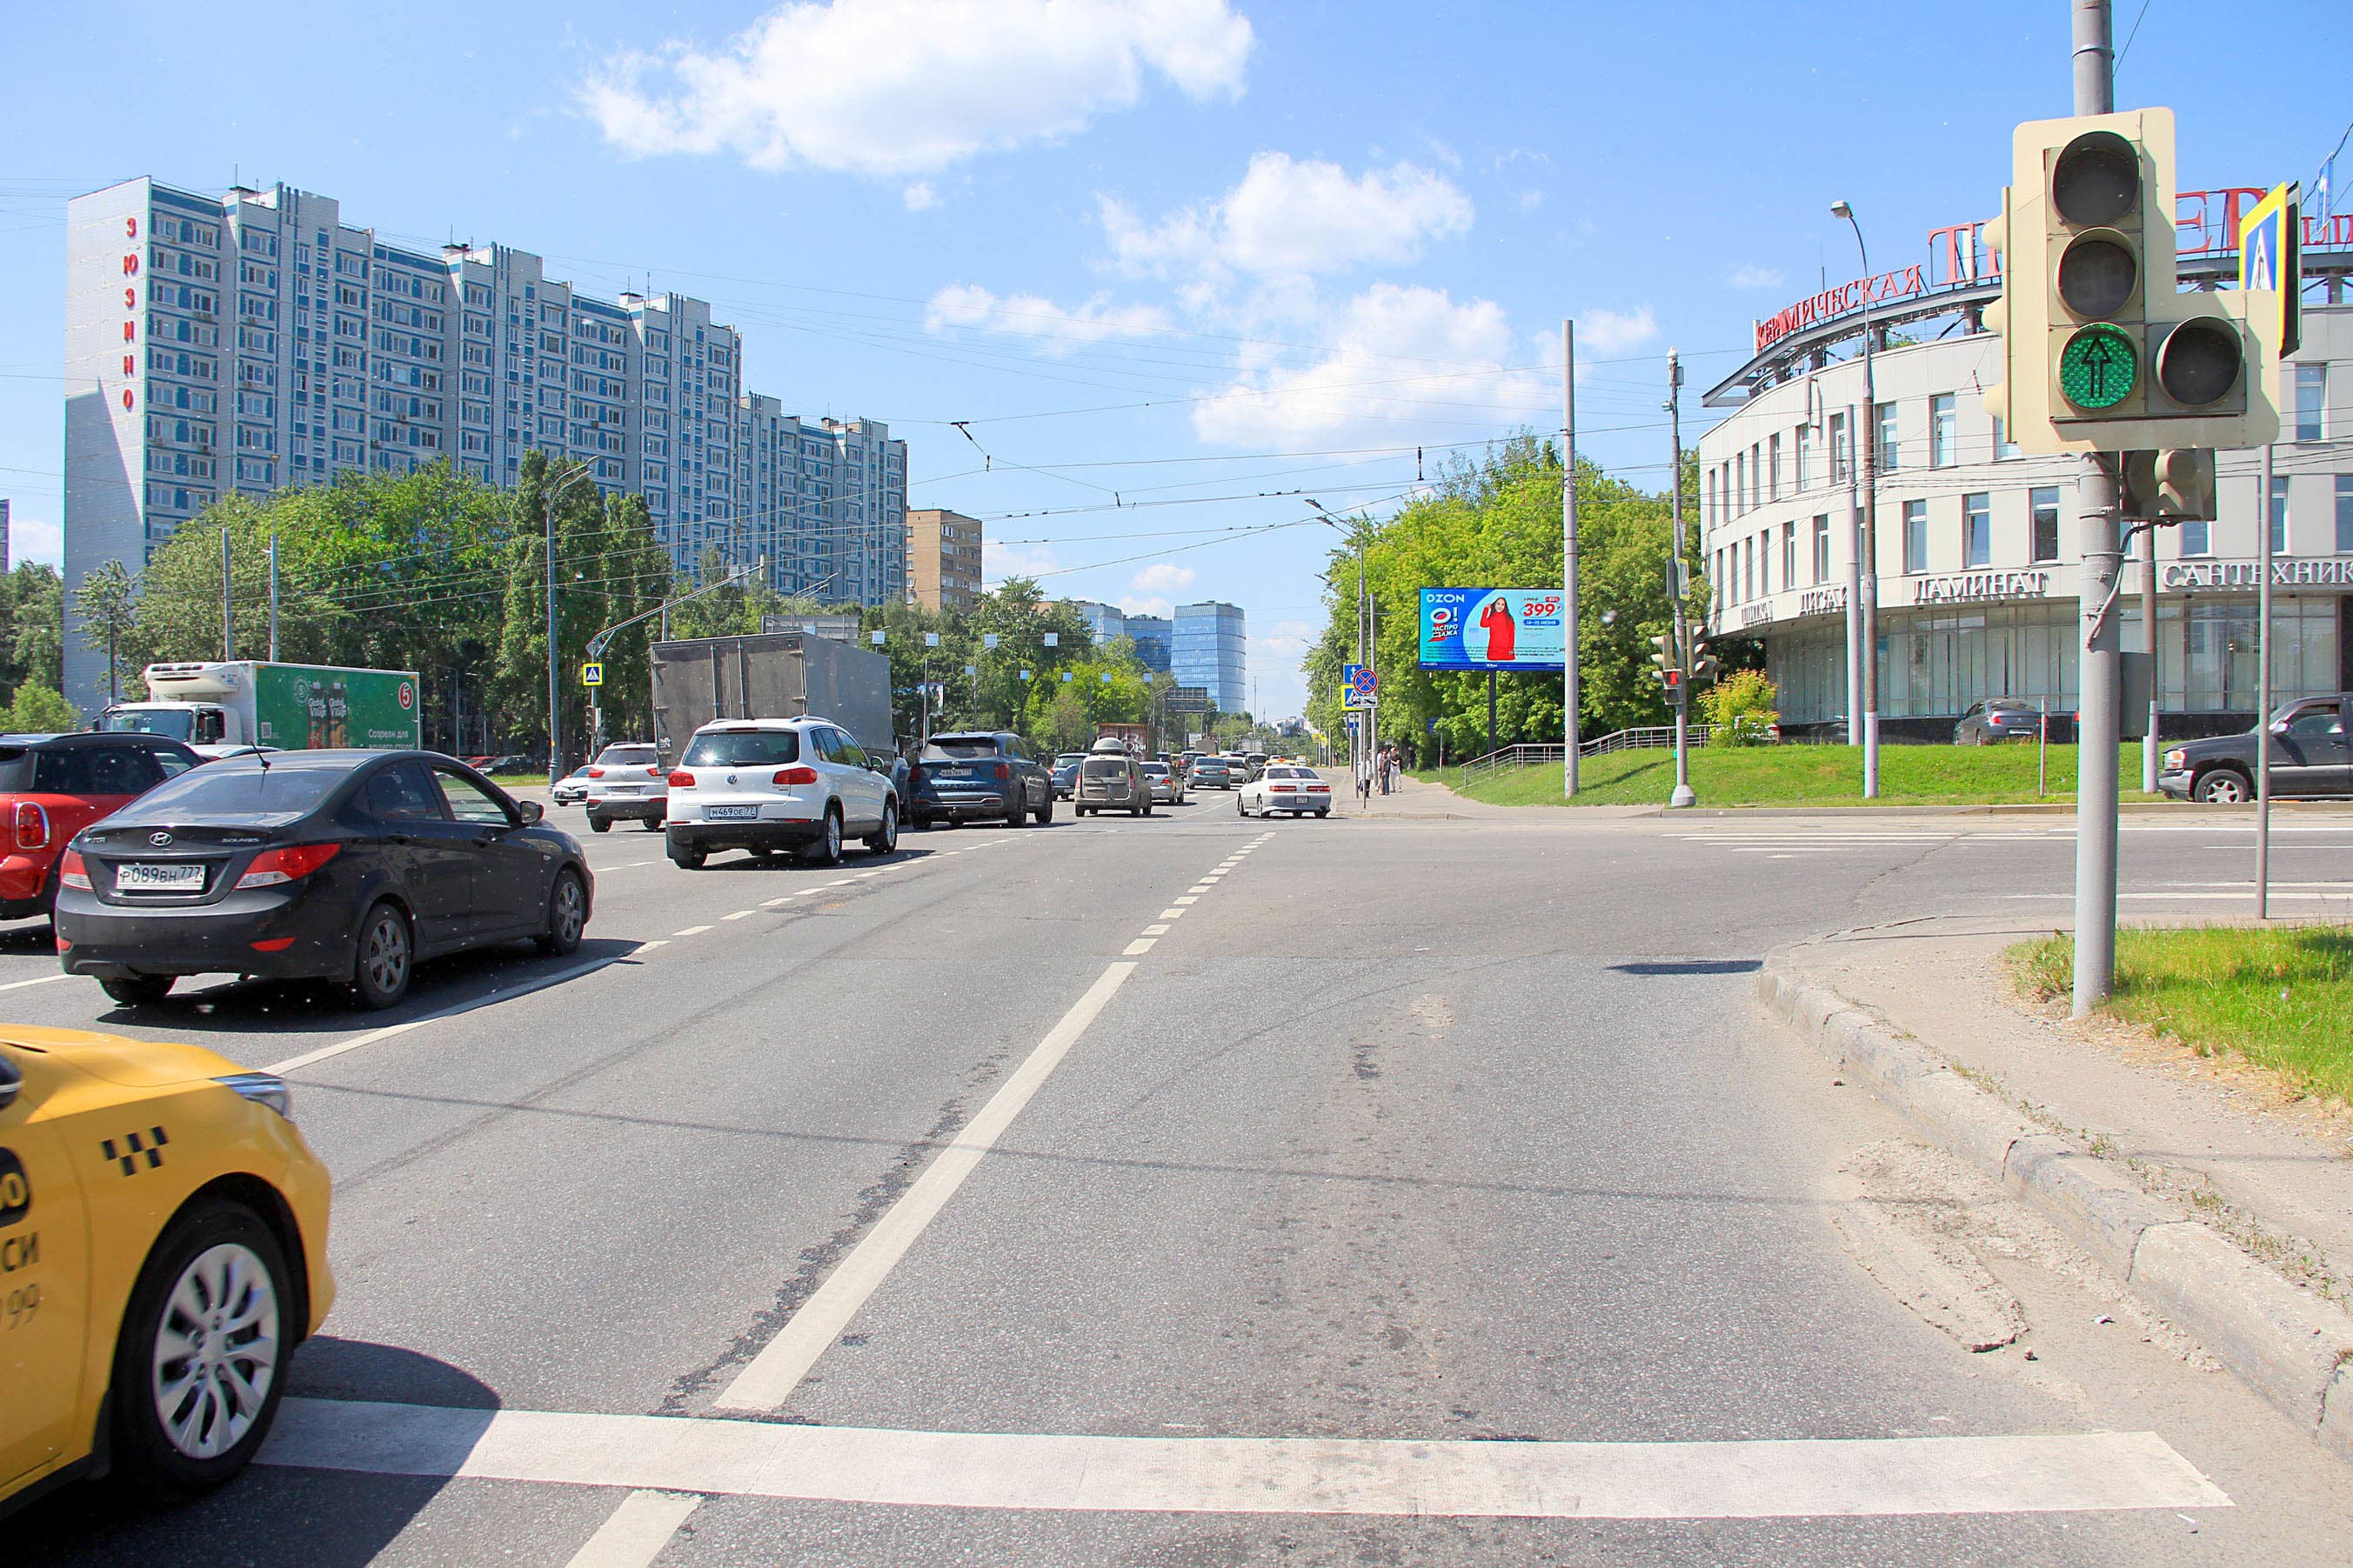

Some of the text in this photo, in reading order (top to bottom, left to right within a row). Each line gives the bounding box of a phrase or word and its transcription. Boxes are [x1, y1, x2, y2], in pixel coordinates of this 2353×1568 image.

[123, 217, 138, 409] ЗЮЗИНО
[1756, 264, 1922, 350] КЕРАМИЧЕСКАЯ
[1427, 594, 1465, 603] OZON
[1913, 571, 2047, 600] ЛАМИНАТ
[1523, 603, 1555, 617] 399
[369, 729, 409, 739] Созрели для
[0, 1231, 40, 1274] СИ
